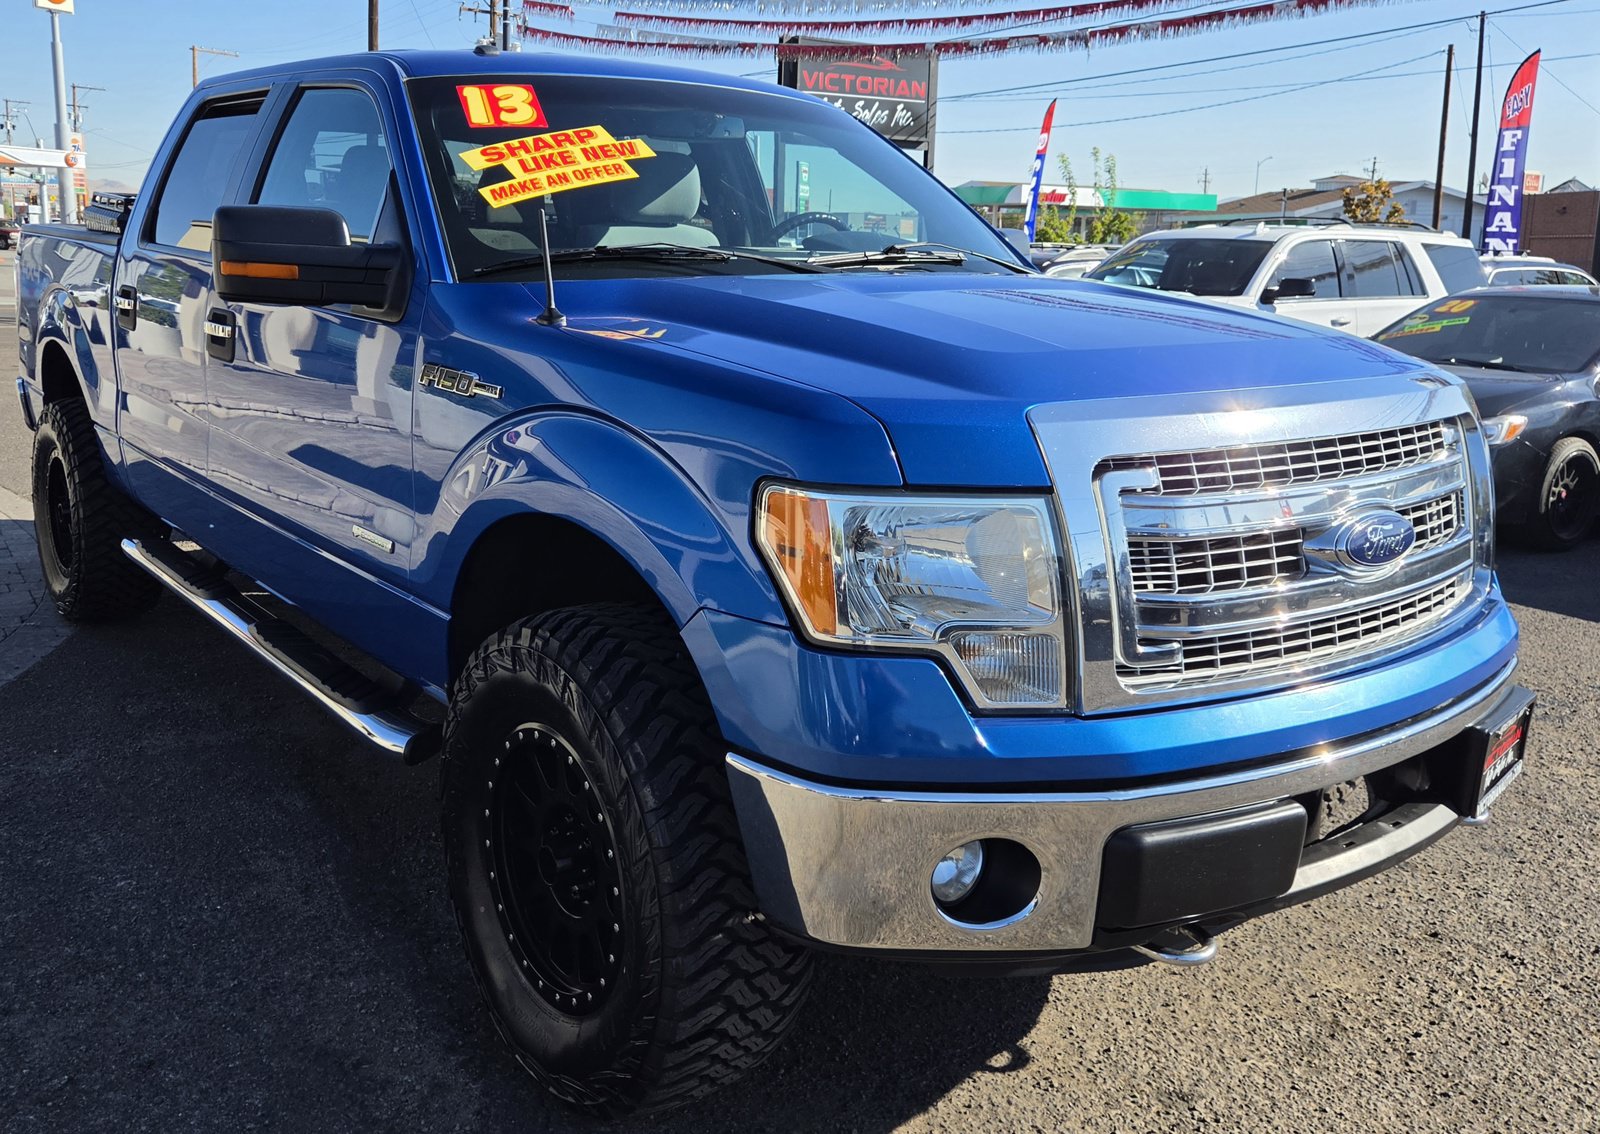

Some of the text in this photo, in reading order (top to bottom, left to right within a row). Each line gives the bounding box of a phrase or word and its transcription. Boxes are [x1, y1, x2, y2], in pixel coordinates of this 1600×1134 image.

[802, 69, 927, 99] VICTORIAN
[1505, 82, 1532, 119] EASY
[463, 85, 538, 126] 13
[852, 100, 889, 127] Sales
[890, 103, 914, 127] Inc.
[480, 128, 597, 163] SHARP
[518, 141, 640, 174] LIKE NEW
[490, 162, 628, 201] MAKE AN OFFER
[1363, 523, 1406, 559] Ford
